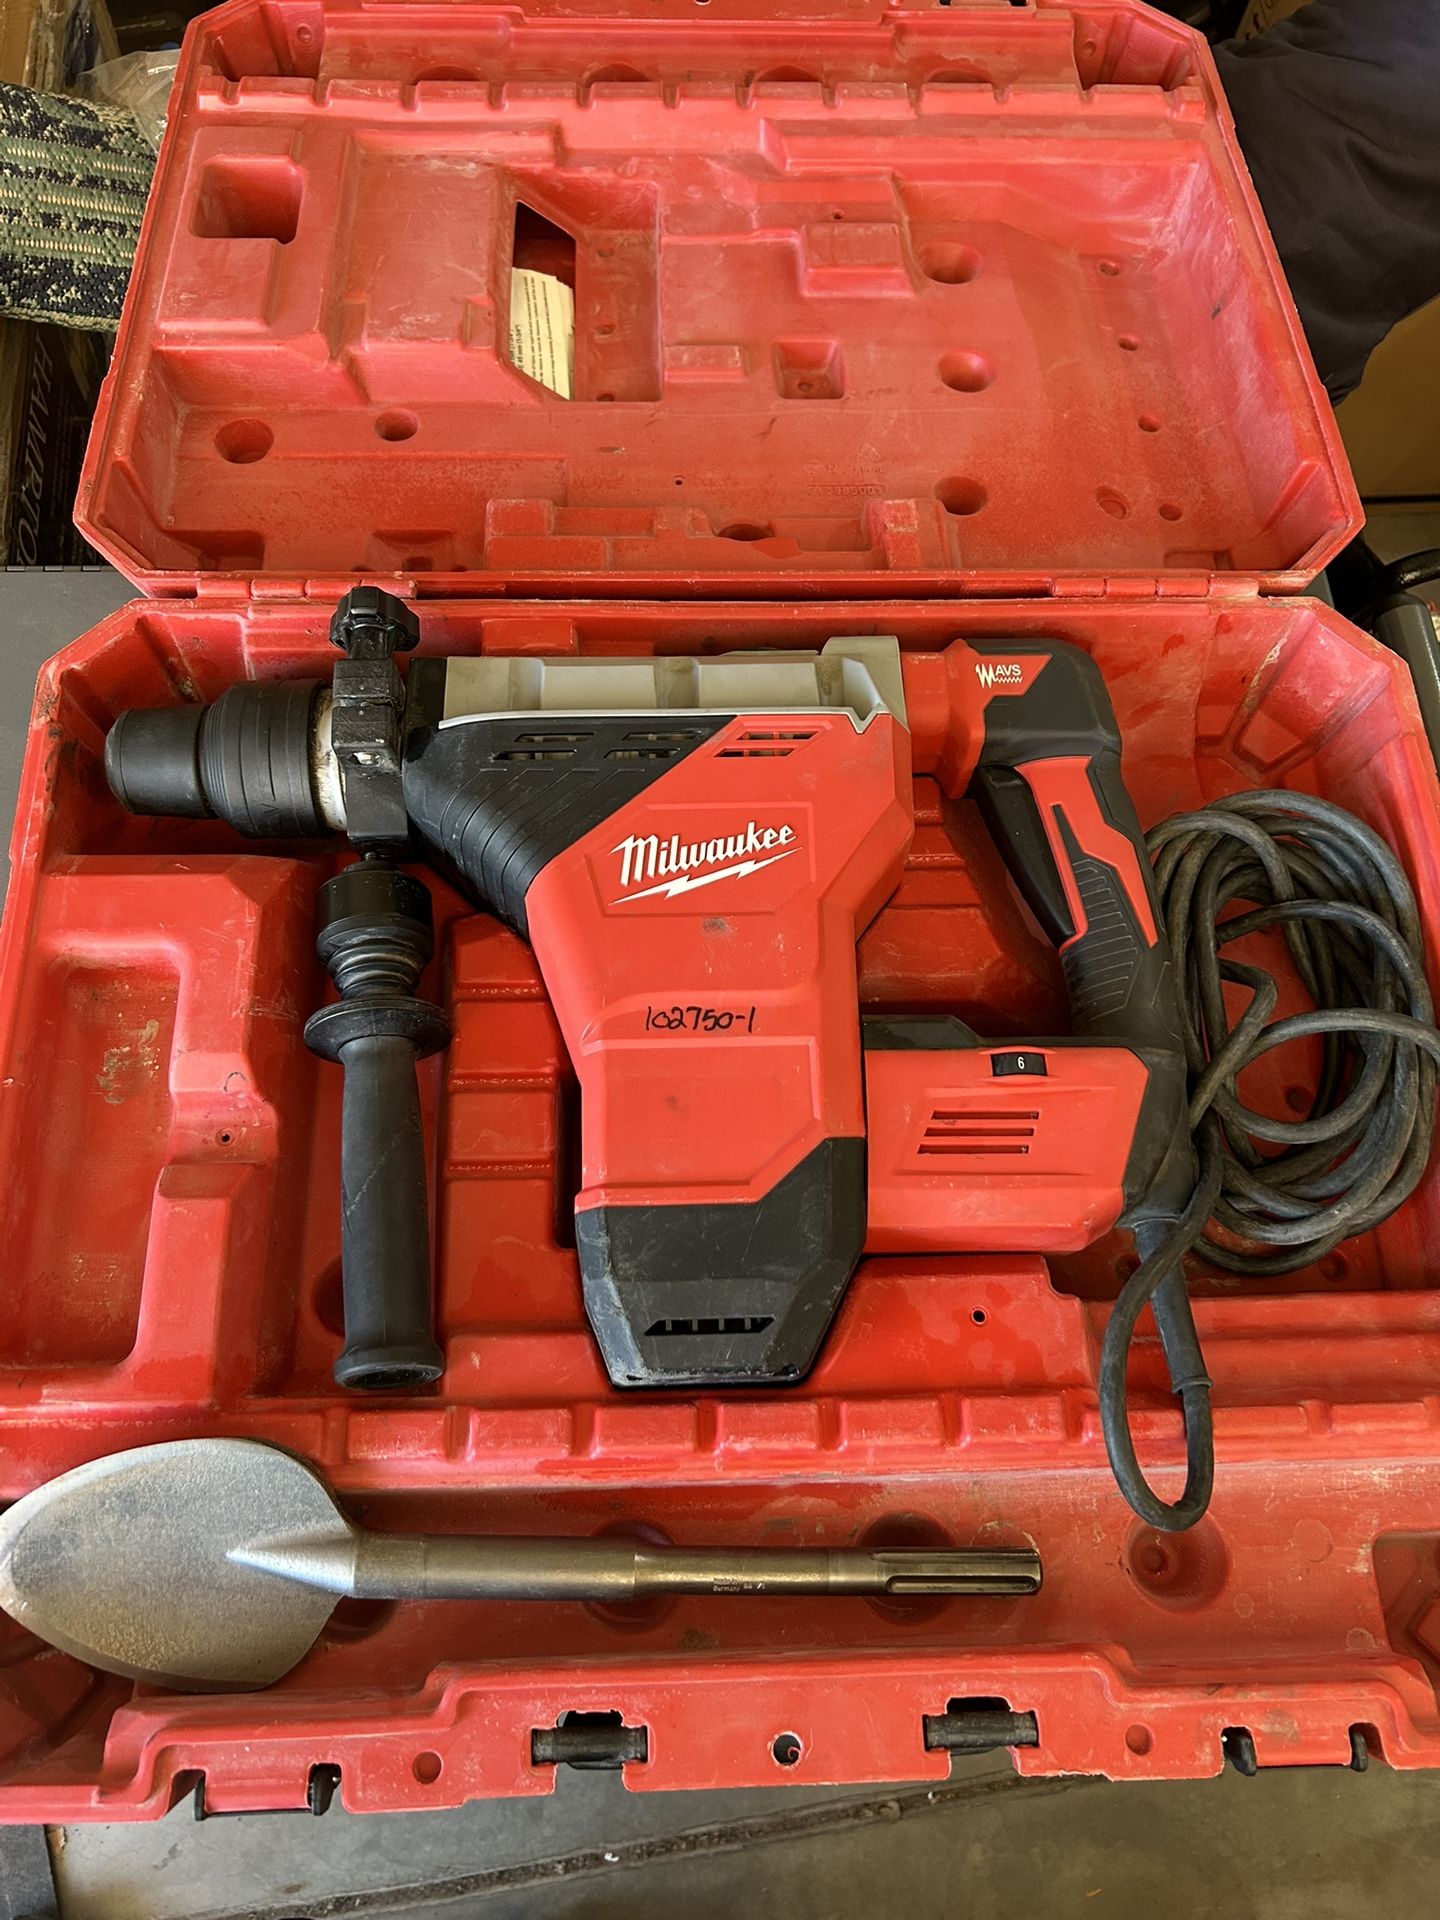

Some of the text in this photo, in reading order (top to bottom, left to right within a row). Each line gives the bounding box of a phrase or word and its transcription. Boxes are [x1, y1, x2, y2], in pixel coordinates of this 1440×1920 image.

[607, 821, 797, 887] Milwaukee
[646, 1005, 756, 1033] 102750-1
[1017, 1056, 1025, 1070] 6
